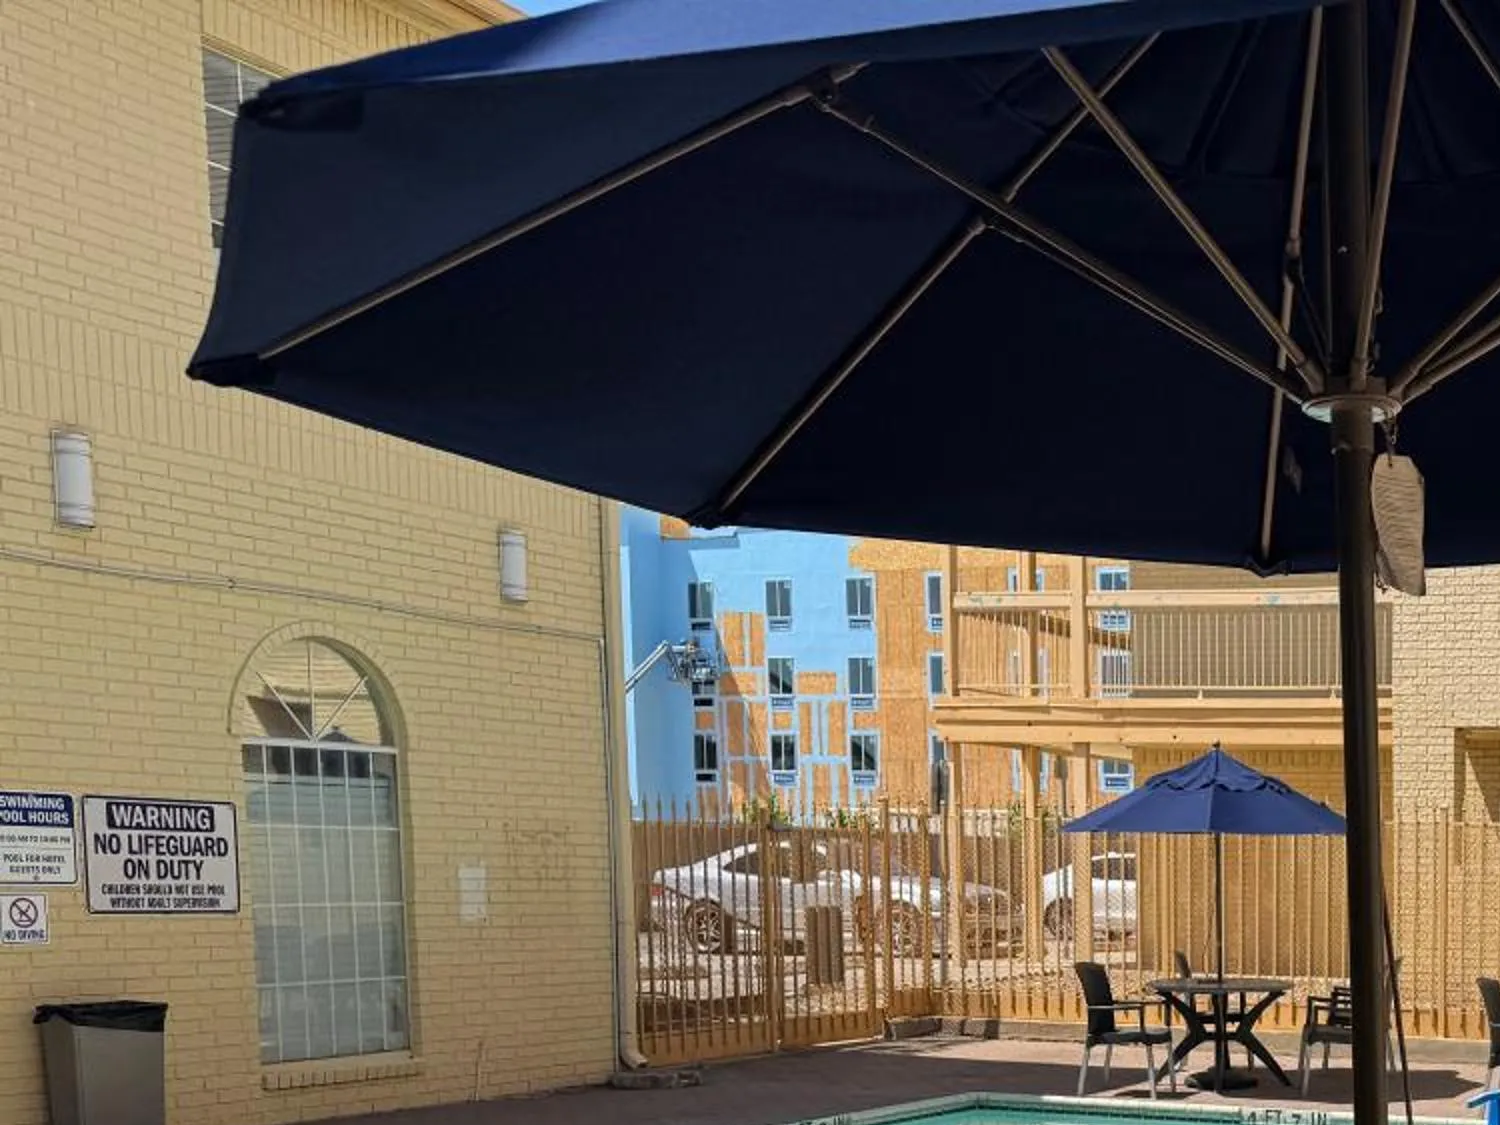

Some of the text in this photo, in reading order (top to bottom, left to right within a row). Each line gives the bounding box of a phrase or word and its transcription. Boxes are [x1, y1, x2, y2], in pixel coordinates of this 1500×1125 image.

[0, 794, 65, 810] SWIMMING
[28, 811, 70, 825] HOURS
[111, 803, 211, 830] WARNING
[93, 832, 229, 857] NO LIFEGUARD
[123, 858, 205, 880] ON DUTY
[101, 883, 226, 897] CHILDREN SHOULD NOT USE POOL
[109, 897, 145, 909] WITHOUT
[172, 898, 221, 909] SUPERVISION
[4, 929, 16, 941] NO
[1265, 1109, 1282, 1125] FT
